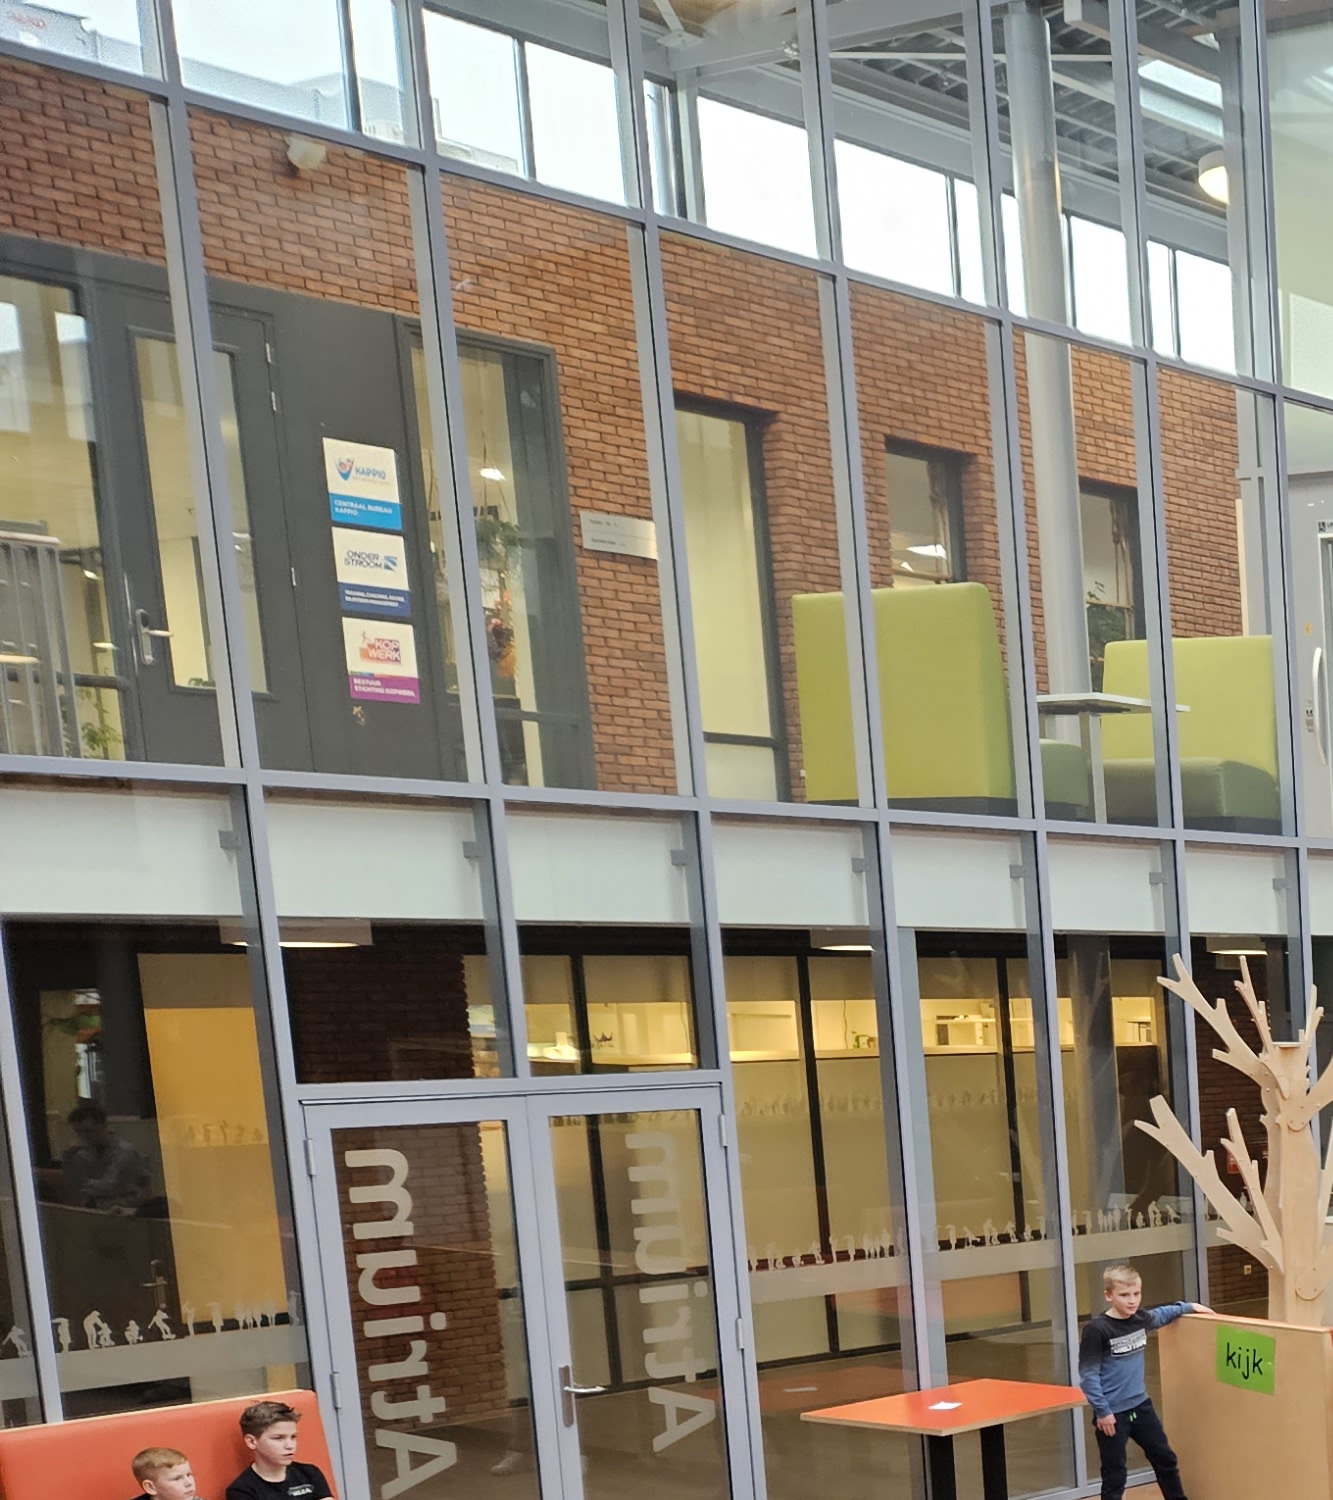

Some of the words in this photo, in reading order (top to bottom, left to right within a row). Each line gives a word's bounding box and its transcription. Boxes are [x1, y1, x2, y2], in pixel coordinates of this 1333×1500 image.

[355, 466, 387, 480] KAPPIO
[346, 549, 380, 561] ONDER
[344, 557, 382, 570] STROOM
[374, 638, 401, 653] KOP
[367, 647, 401, 662] WERK
[1226, 1341, 1264, 1380] kijk
